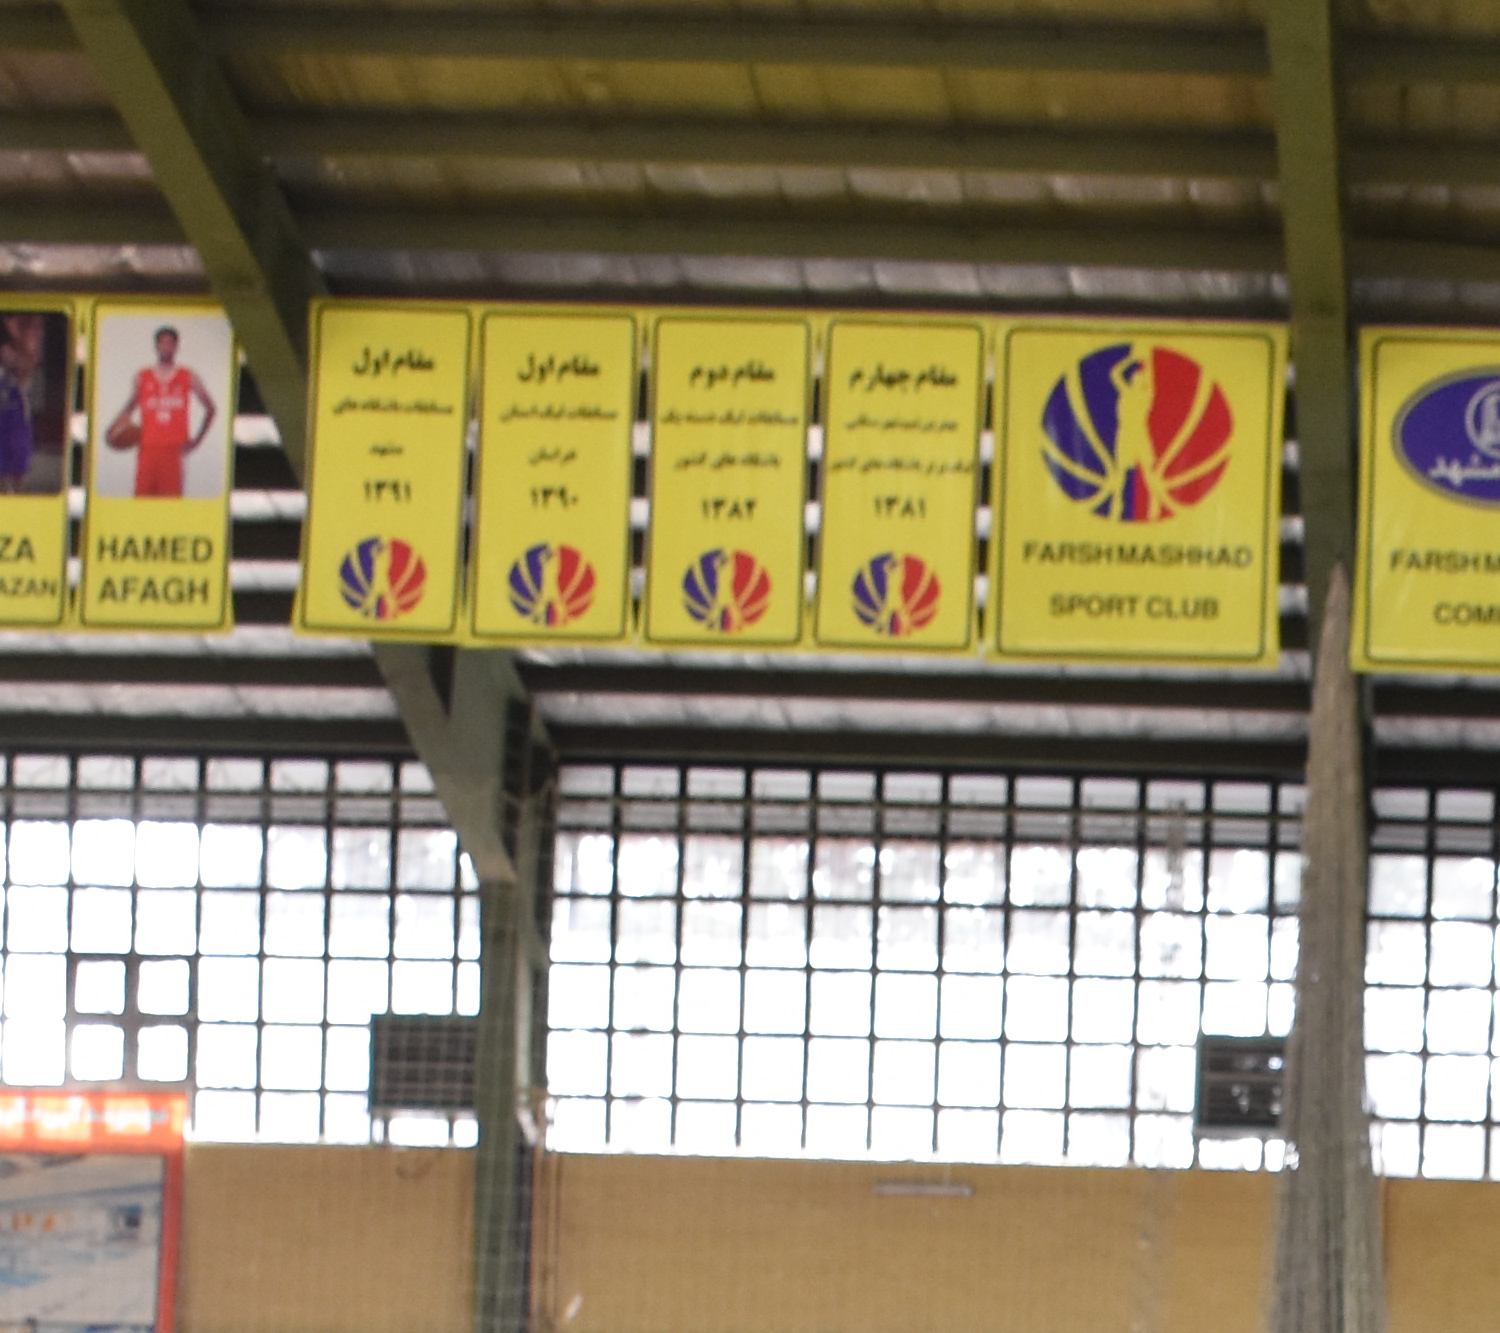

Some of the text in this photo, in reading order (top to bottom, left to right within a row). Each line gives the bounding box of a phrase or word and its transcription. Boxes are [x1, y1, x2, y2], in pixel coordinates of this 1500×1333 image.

[352, 348, 390, 377] اول
[517, 352, 556, 384] اول
[97, 537, 214, 565] HAMED
[98, 577, 210, 606] AFAGH
[1050, 592, 1220, 620] SPORT CLUB
